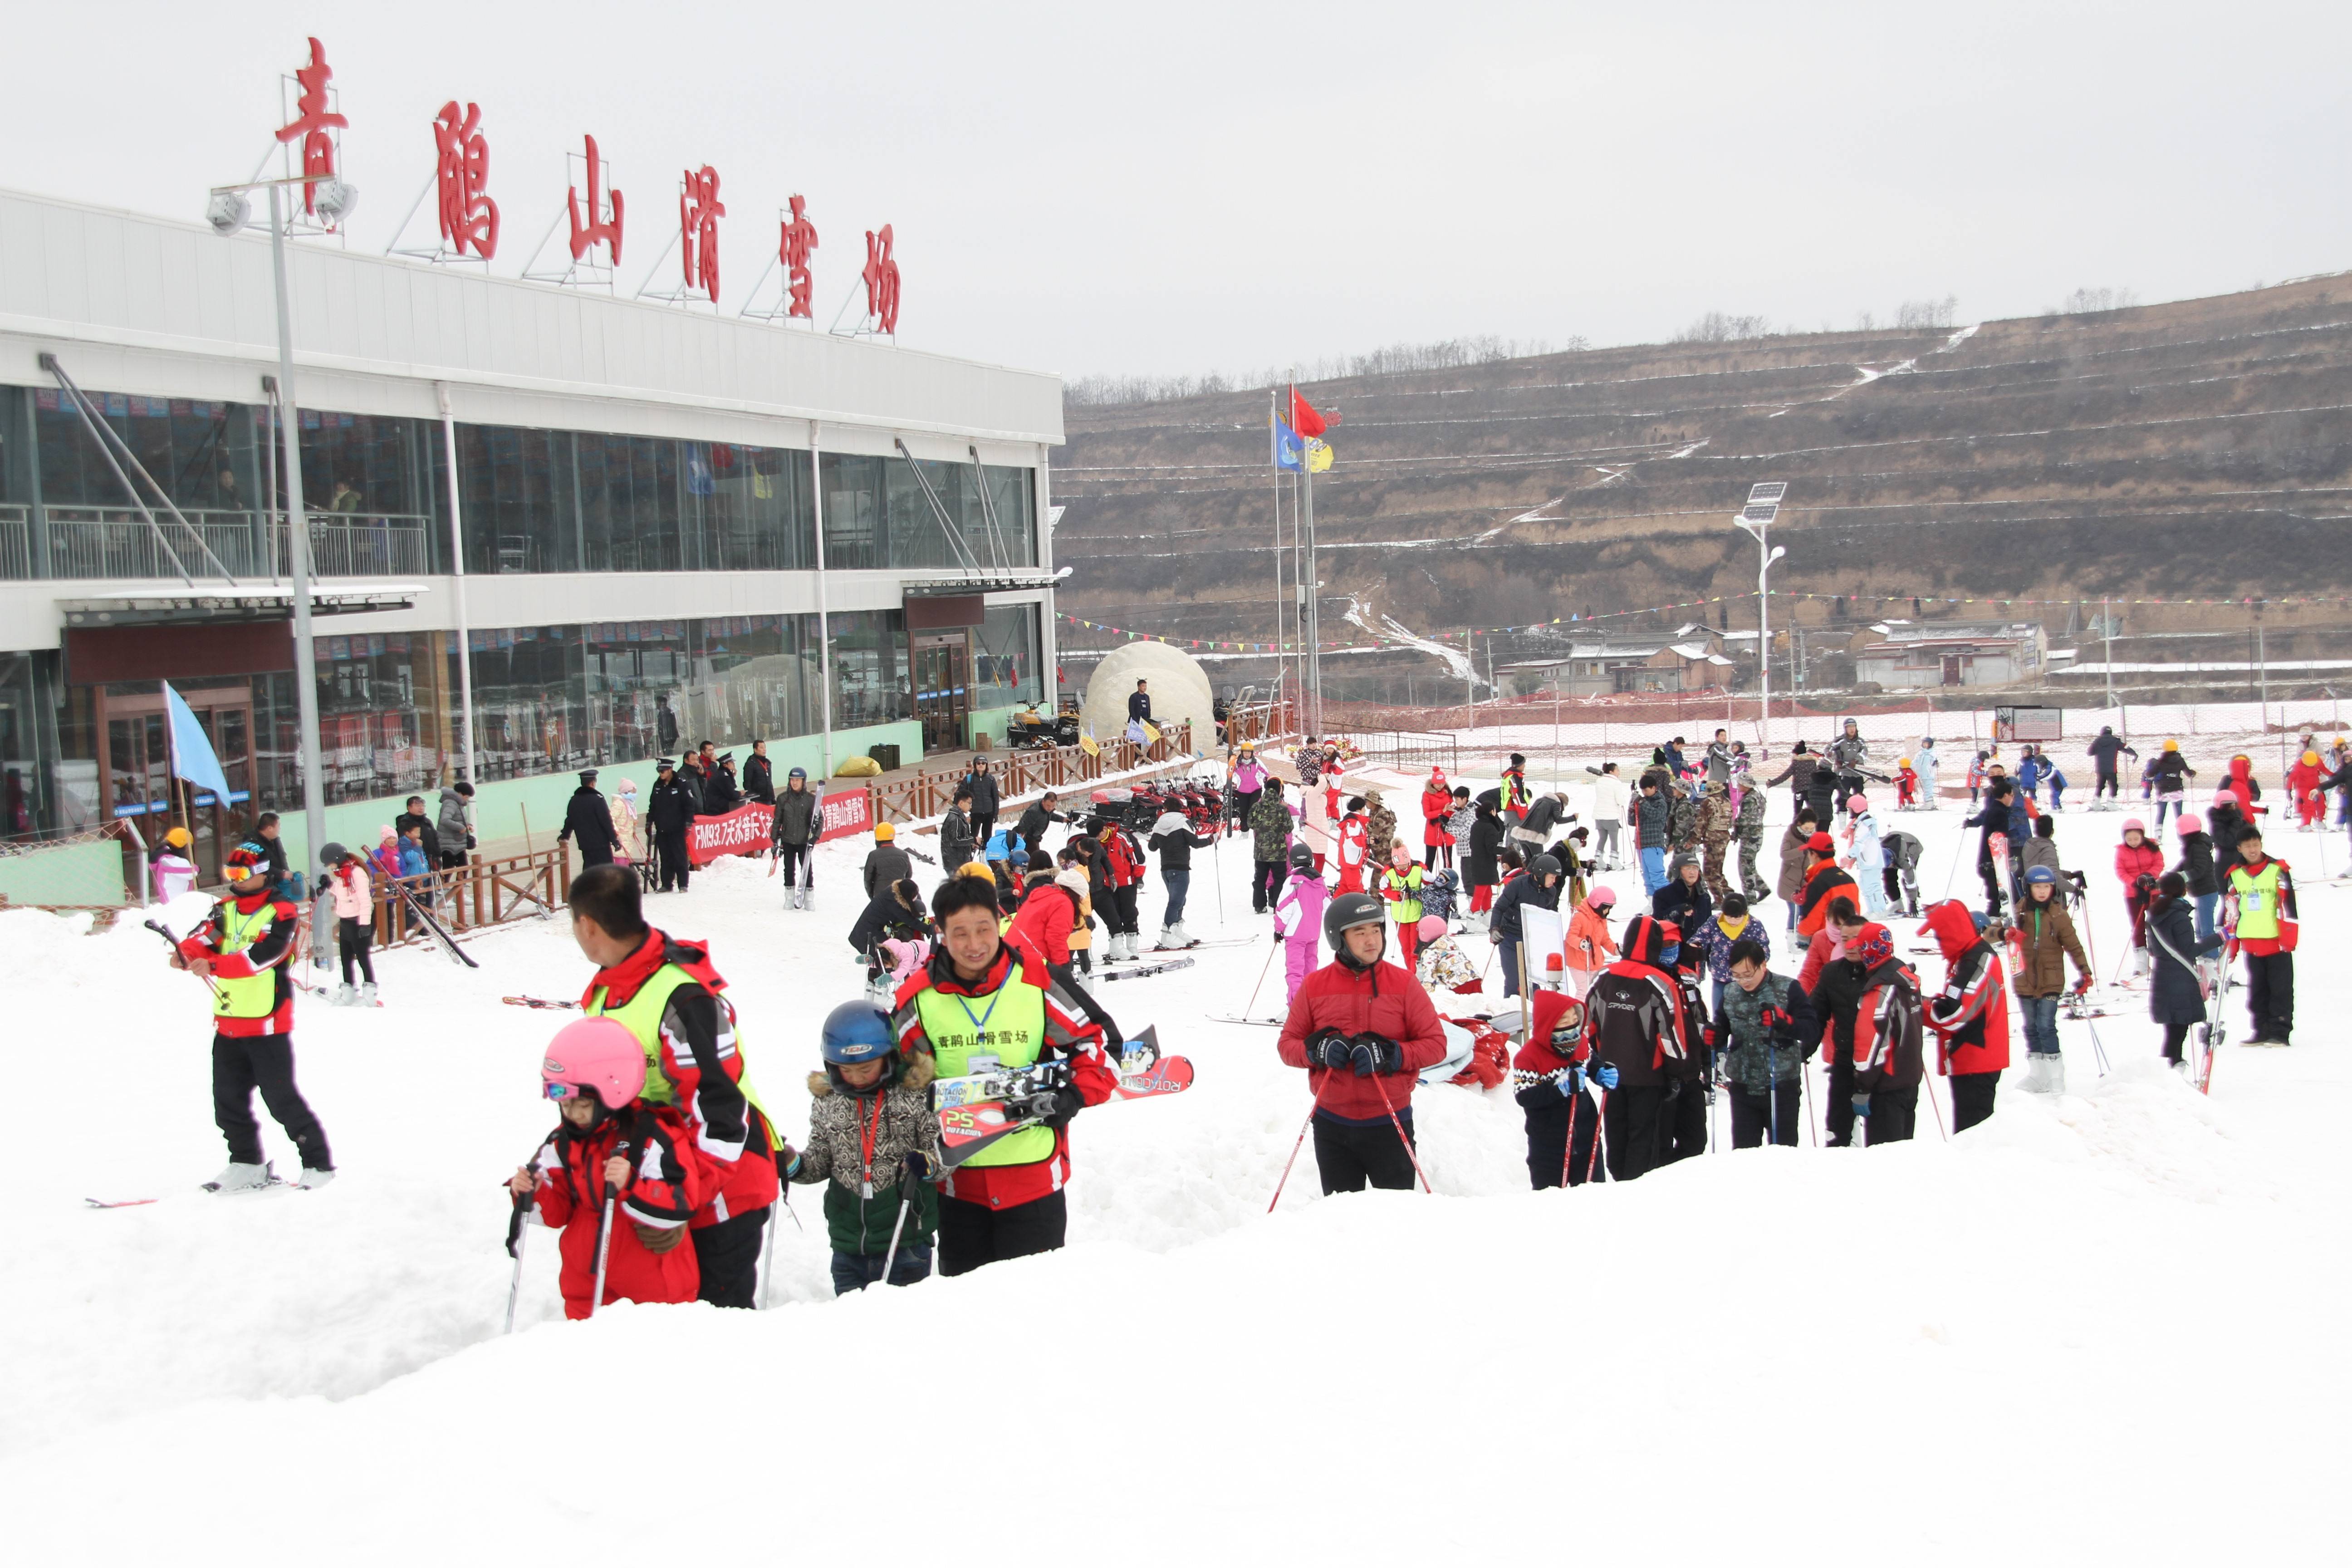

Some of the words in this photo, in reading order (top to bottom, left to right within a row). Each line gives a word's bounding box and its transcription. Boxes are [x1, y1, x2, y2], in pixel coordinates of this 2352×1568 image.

[1607, 1002, 1636, 1012] SPYDER
[937, 1030, 1029, 1049] 青鹃山滑雪场
[1371, 1042, 1380, 1064] SPORTS
[1129, 1075, 1181, 1092] ROTACION
[946, 1110, 974, 1128] PS
[946, 1126, 983, 1137] ROTACION
